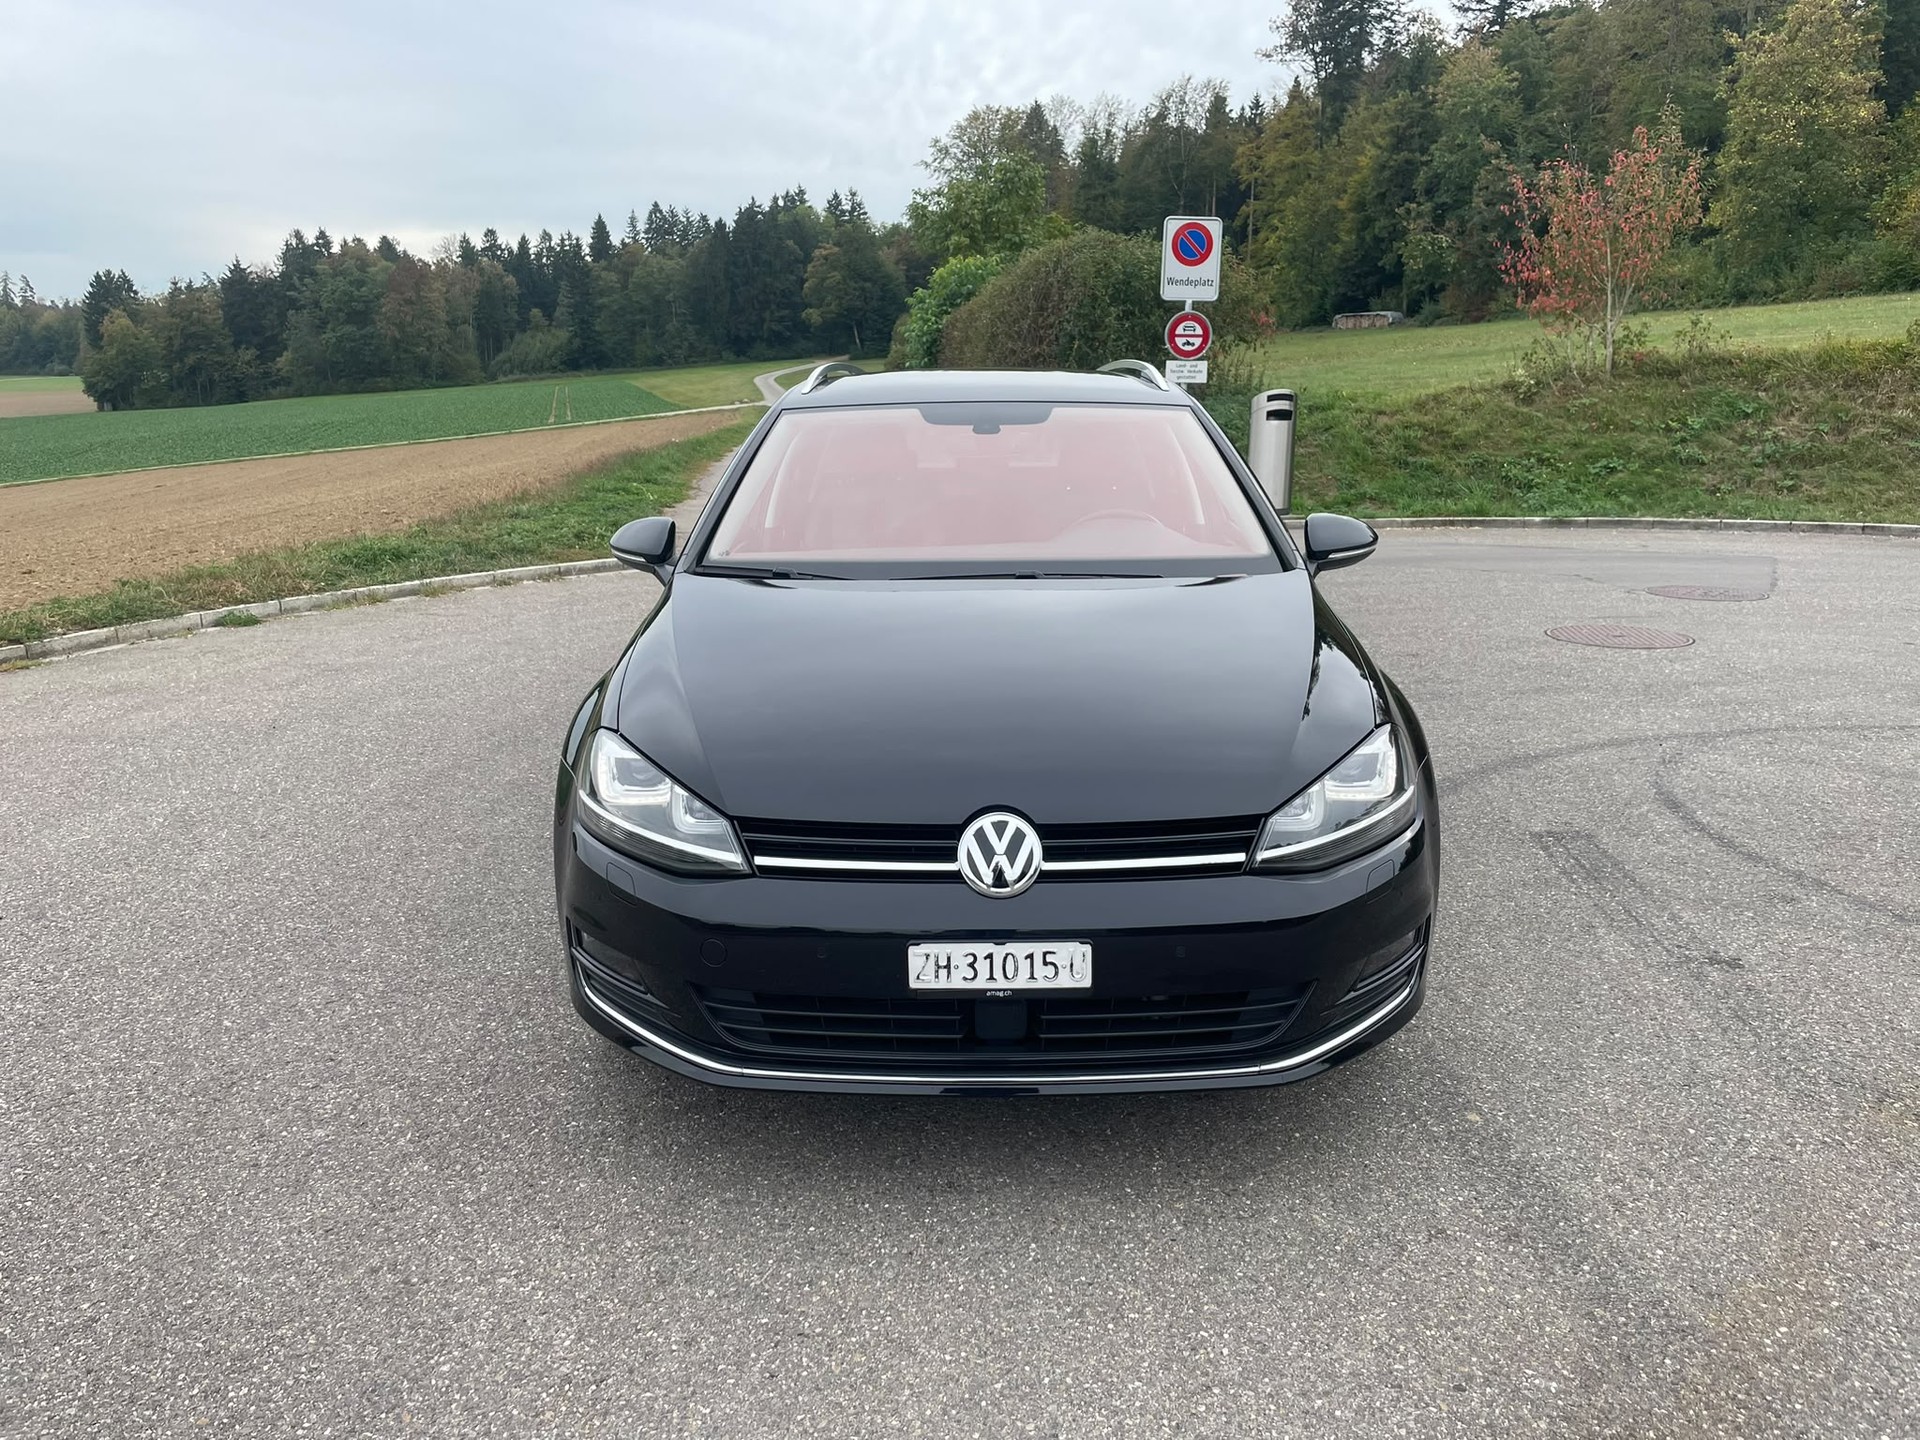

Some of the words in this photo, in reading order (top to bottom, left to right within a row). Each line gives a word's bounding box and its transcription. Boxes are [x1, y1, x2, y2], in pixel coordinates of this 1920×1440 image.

[1166, 276, 1215, 289] Wendeplatz
[960, 814, 1040, 893] VW
[985, 989, 1013, 998] amag.ch
